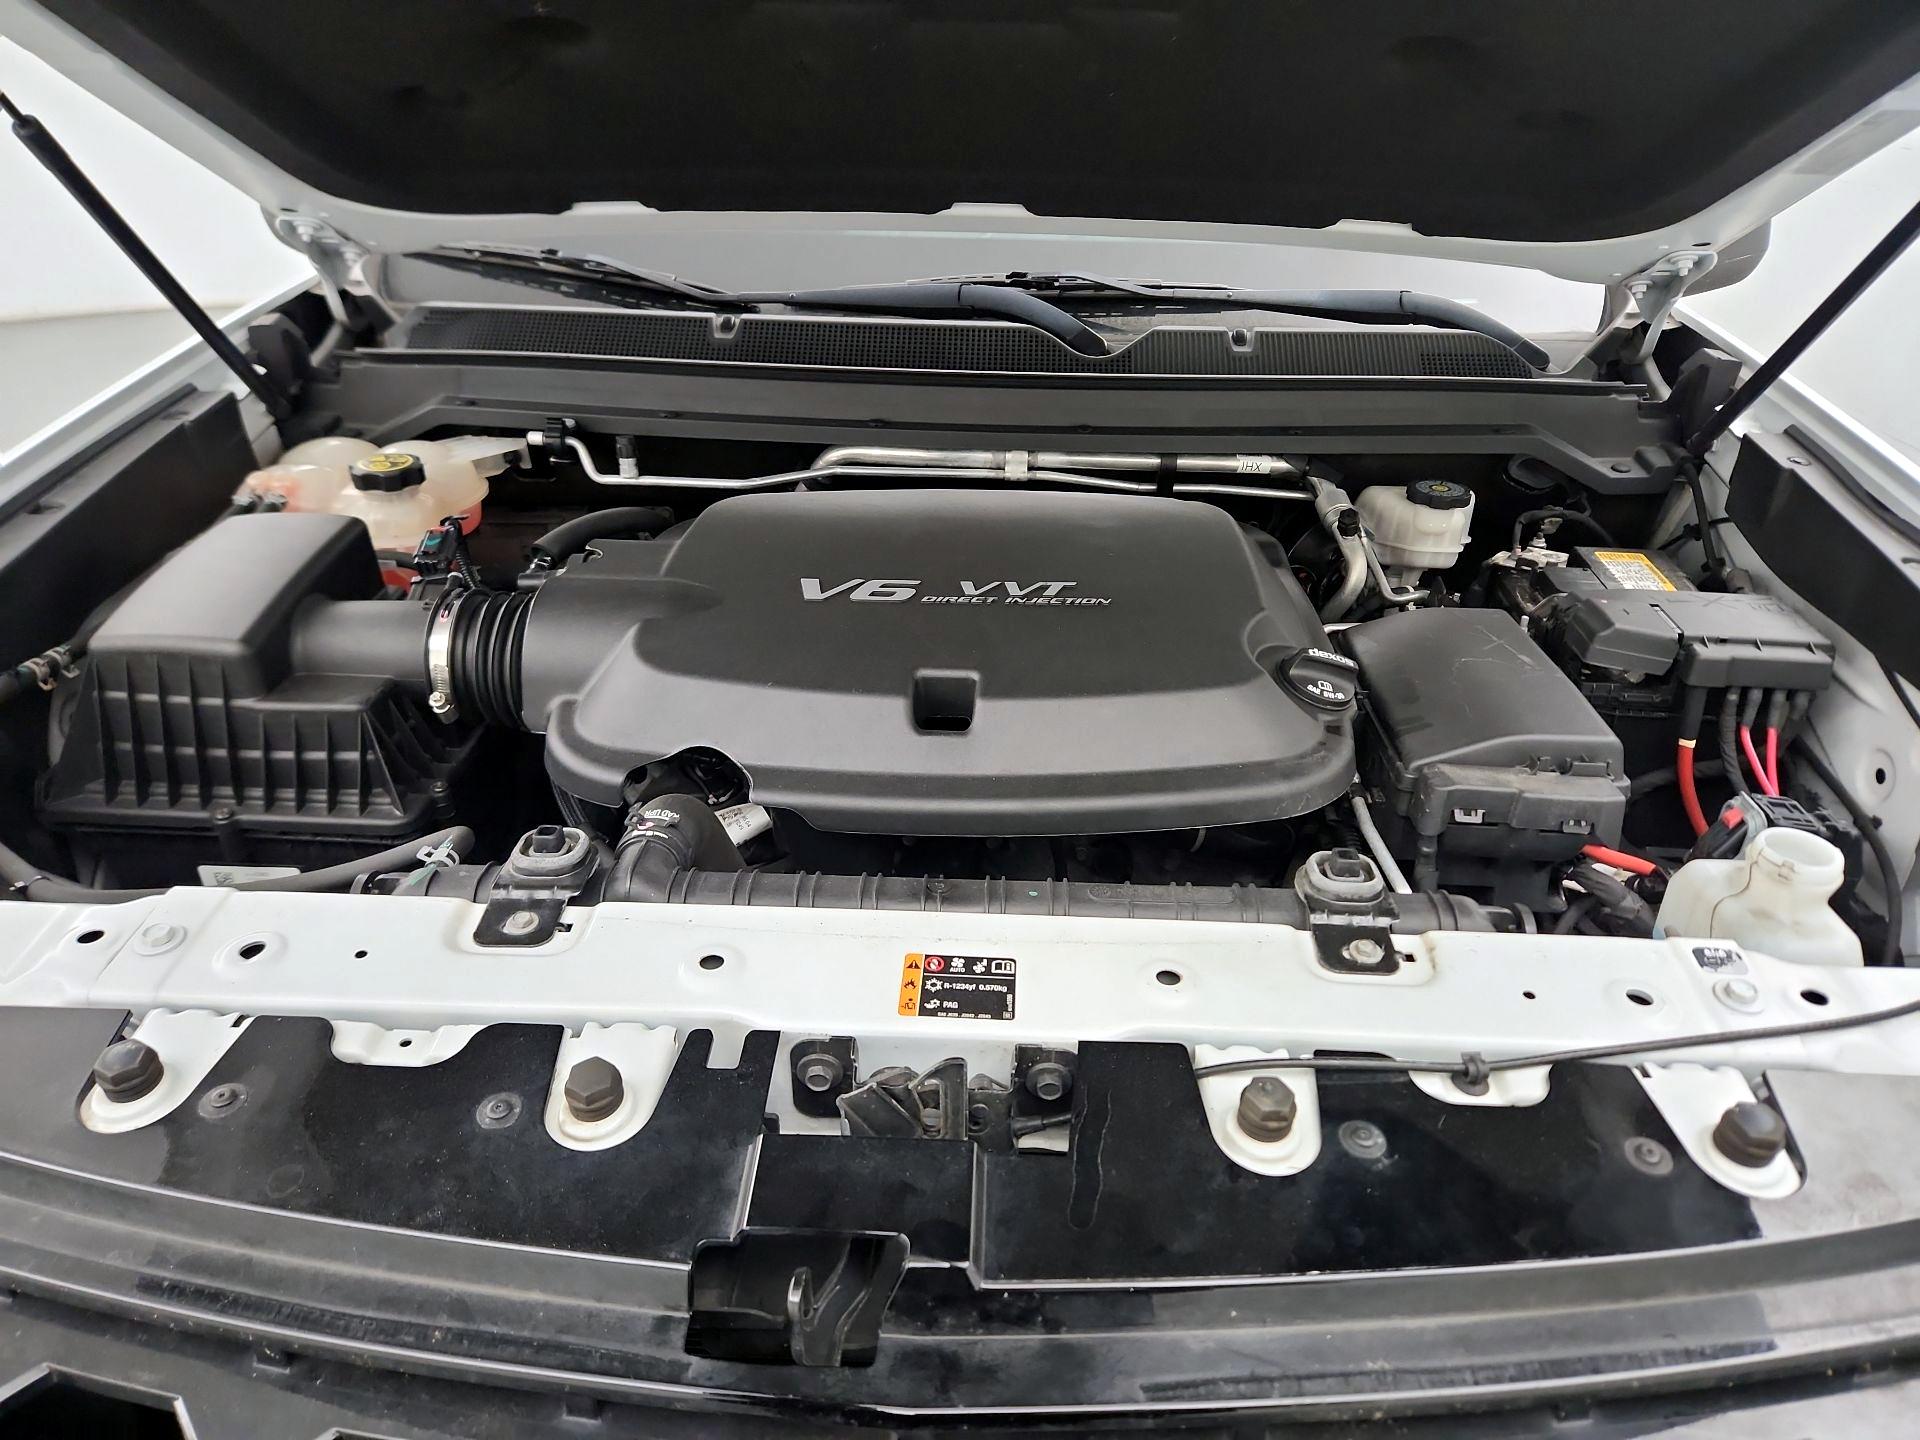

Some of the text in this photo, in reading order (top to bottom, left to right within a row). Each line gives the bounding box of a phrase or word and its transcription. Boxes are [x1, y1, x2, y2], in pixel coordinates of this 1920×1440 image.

[801, 578, 1077, 601] V6 VVT
[921, 596, 1112, 606] DIRECT INJECTION
[1308, 648, 1355, 667] dexos
[943, 982, 976, 992] R-1234yf
